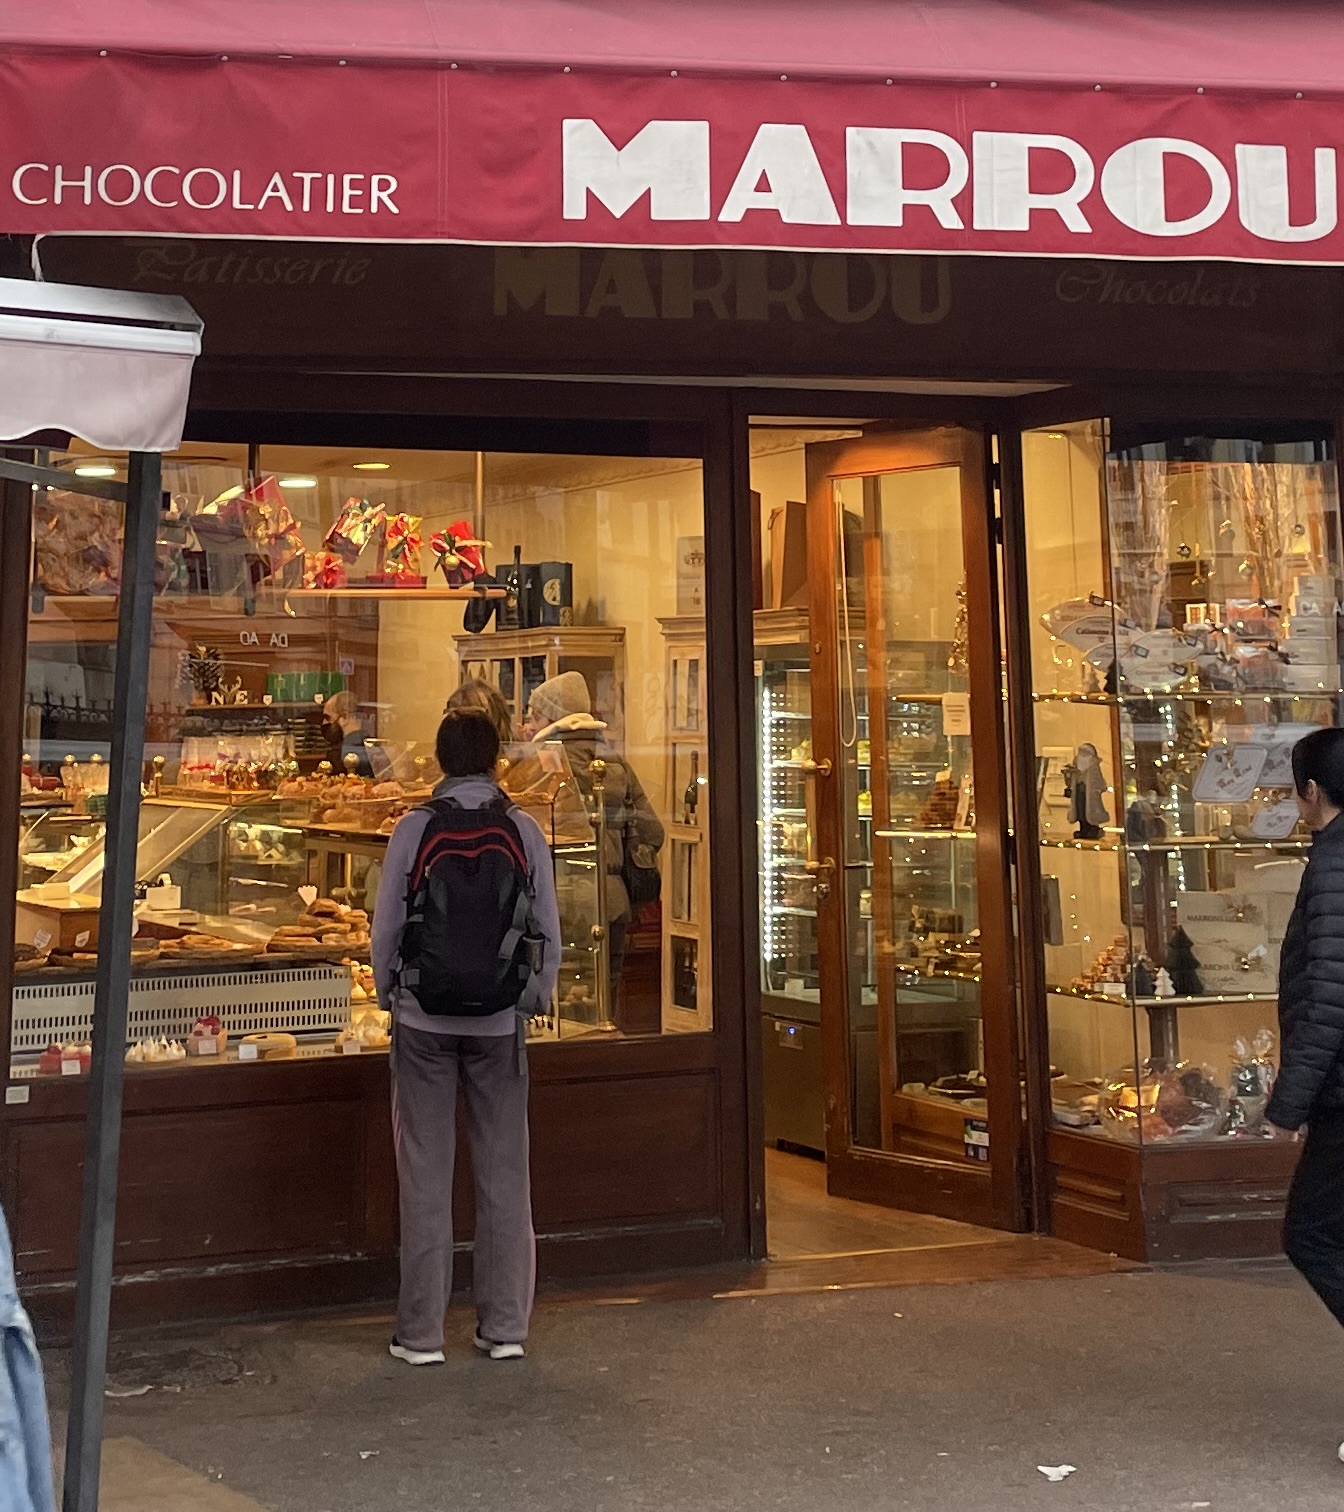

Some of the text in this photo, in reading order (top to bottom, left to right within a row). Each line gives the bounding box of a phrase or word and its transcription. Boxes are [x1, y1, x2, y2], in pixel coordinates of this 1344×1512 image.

[10, 162, 400, 215] CHOCOLATIER
[560, 117, 1340, 244] MARROU
[493, 248, 954, 325] MARROU
